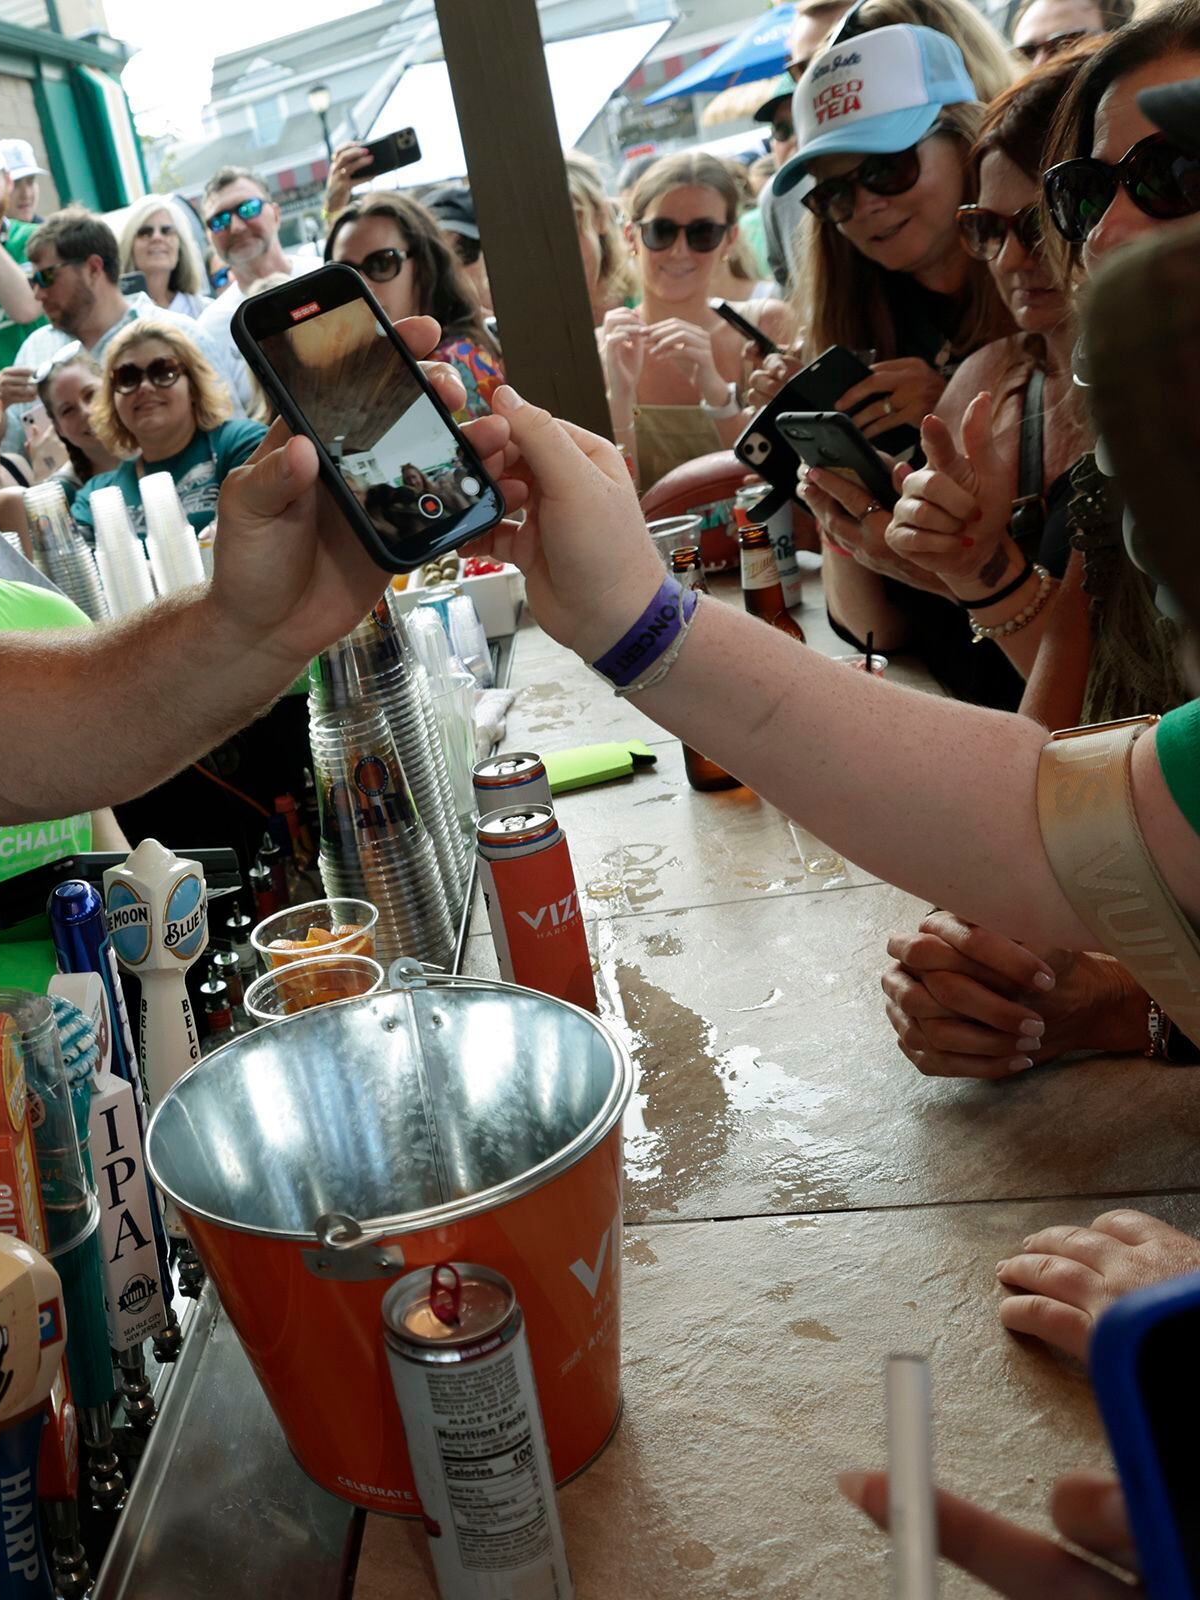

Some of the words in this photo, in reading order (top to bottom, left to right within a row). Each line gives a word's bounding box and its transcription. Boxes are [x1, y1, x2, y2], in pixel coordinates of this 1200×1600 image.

[813, 80, 864, 110] ICED
[816, 96, 862, 125] TEA
[114, 906, 148, 930] MOON
[181, 998, 199, 1065] BELG
[100, 1104, 152, 1264] IPA
[437, 1427, 496, 1442] Nutrition
[498, 1409, 527, 1433] Facts
[448, 1415, 483, 1426] MADE
[487, 1404, 513, 1421] PURE
[512, 1443, 533, 1467] 100
[445, 1466, 494, 1478] Calories
[337, 1475, 414, 1501] CELEBRATE
[0, 1466, 40, 1581] HARP
